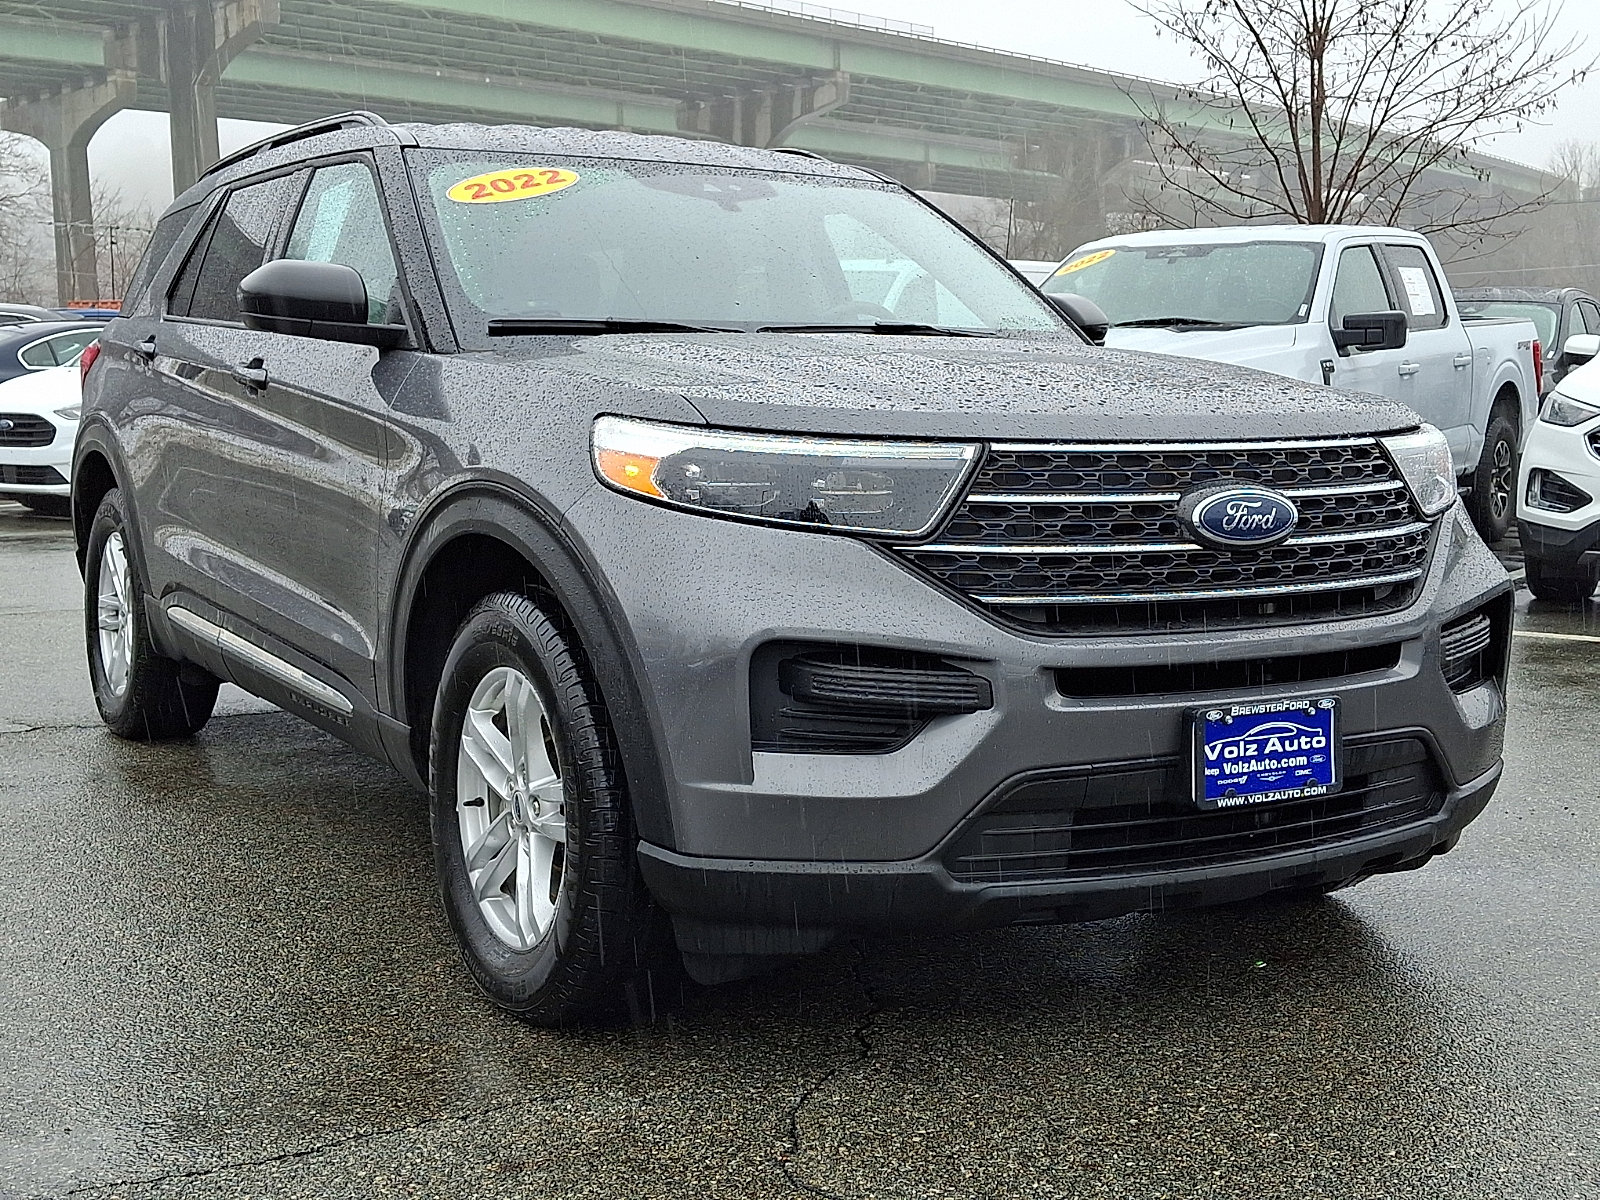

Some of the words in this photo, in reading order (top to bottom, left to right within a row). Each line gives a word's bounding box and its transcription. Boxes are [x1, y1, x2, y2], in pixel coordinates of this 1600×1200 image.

[464, 170, 567, 199] 2022
[1222, 500, 1277, 531] Ford
[1204, 741, 1258, 761] Volz
[1263, 736, 1326, 754] Auto
[1223, 756, 1308, 775] VolzAuto.com
[1217, 786, 1327, 807] WWW.VOLZAUTO.COM
